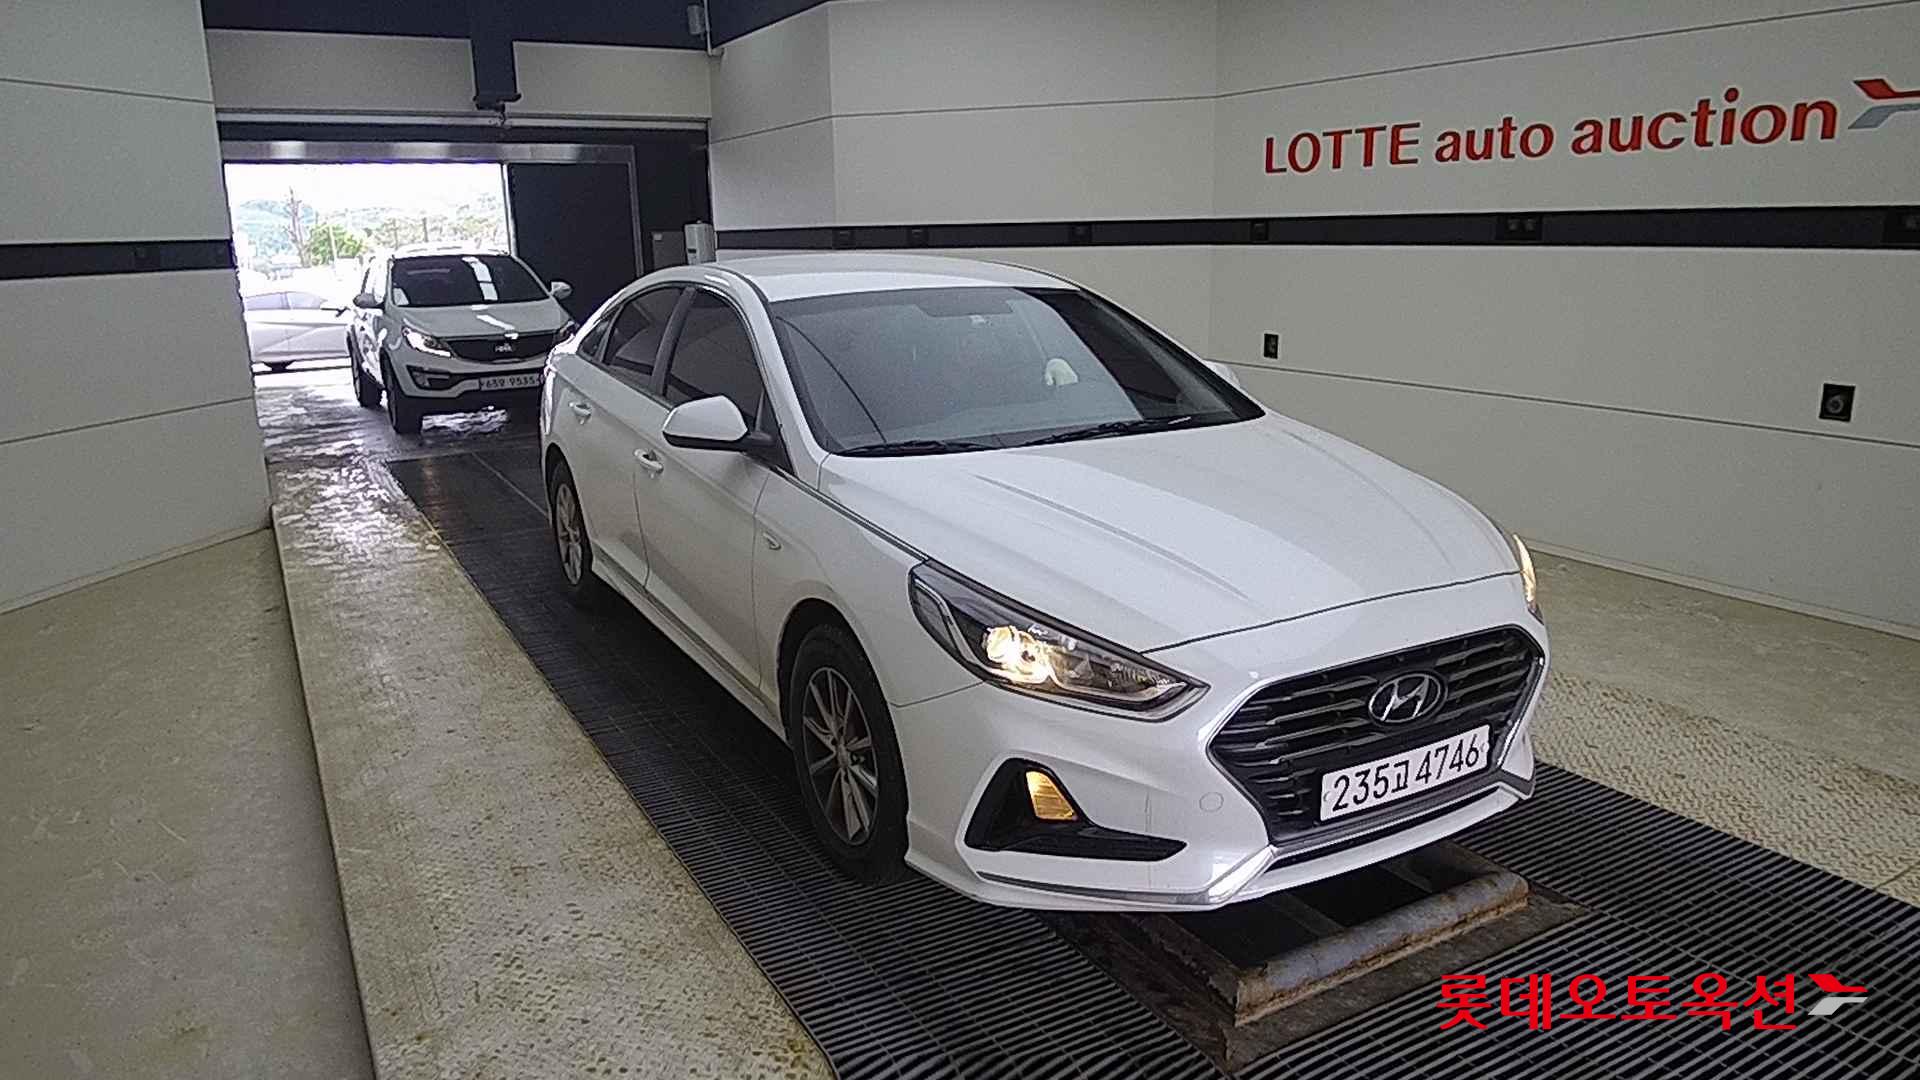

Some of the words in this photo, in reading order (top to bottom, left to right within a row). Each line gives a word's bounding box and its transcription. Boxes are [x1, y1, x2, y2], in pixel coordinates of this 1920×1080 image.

[1264, 122, 1421, 174] LOTTE
[1434, 116, 1554, 162] auto
[1570, 87, 1838, 153] auction
[1332, 759, 1410, 812] 235고
[1415, 733, 1480, 785] 4746
